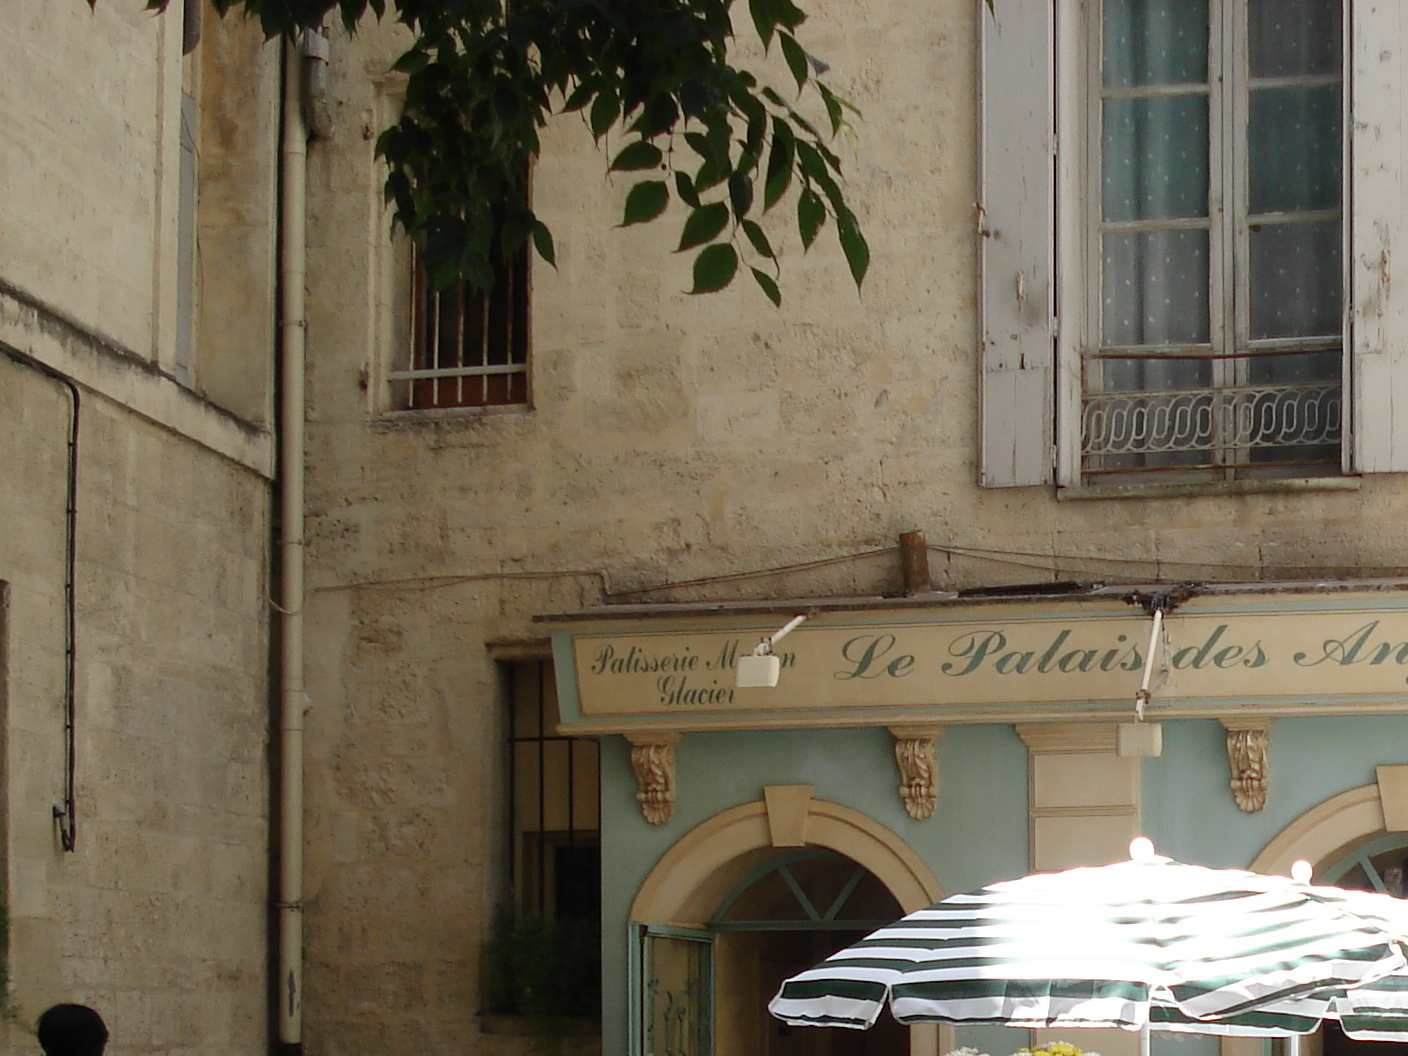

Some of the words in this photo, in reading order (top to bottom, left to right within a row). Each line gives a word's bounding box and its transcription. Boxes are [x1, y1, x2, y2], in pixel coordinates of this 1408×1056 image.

[590, 643, 700, 675] Patisserie
[833, 633, 916, 680] Le
[941, 629, 1143, 677] Palais
[1171, 624, 1270, 670] des
[656, 675, 736, 706] Glacier
